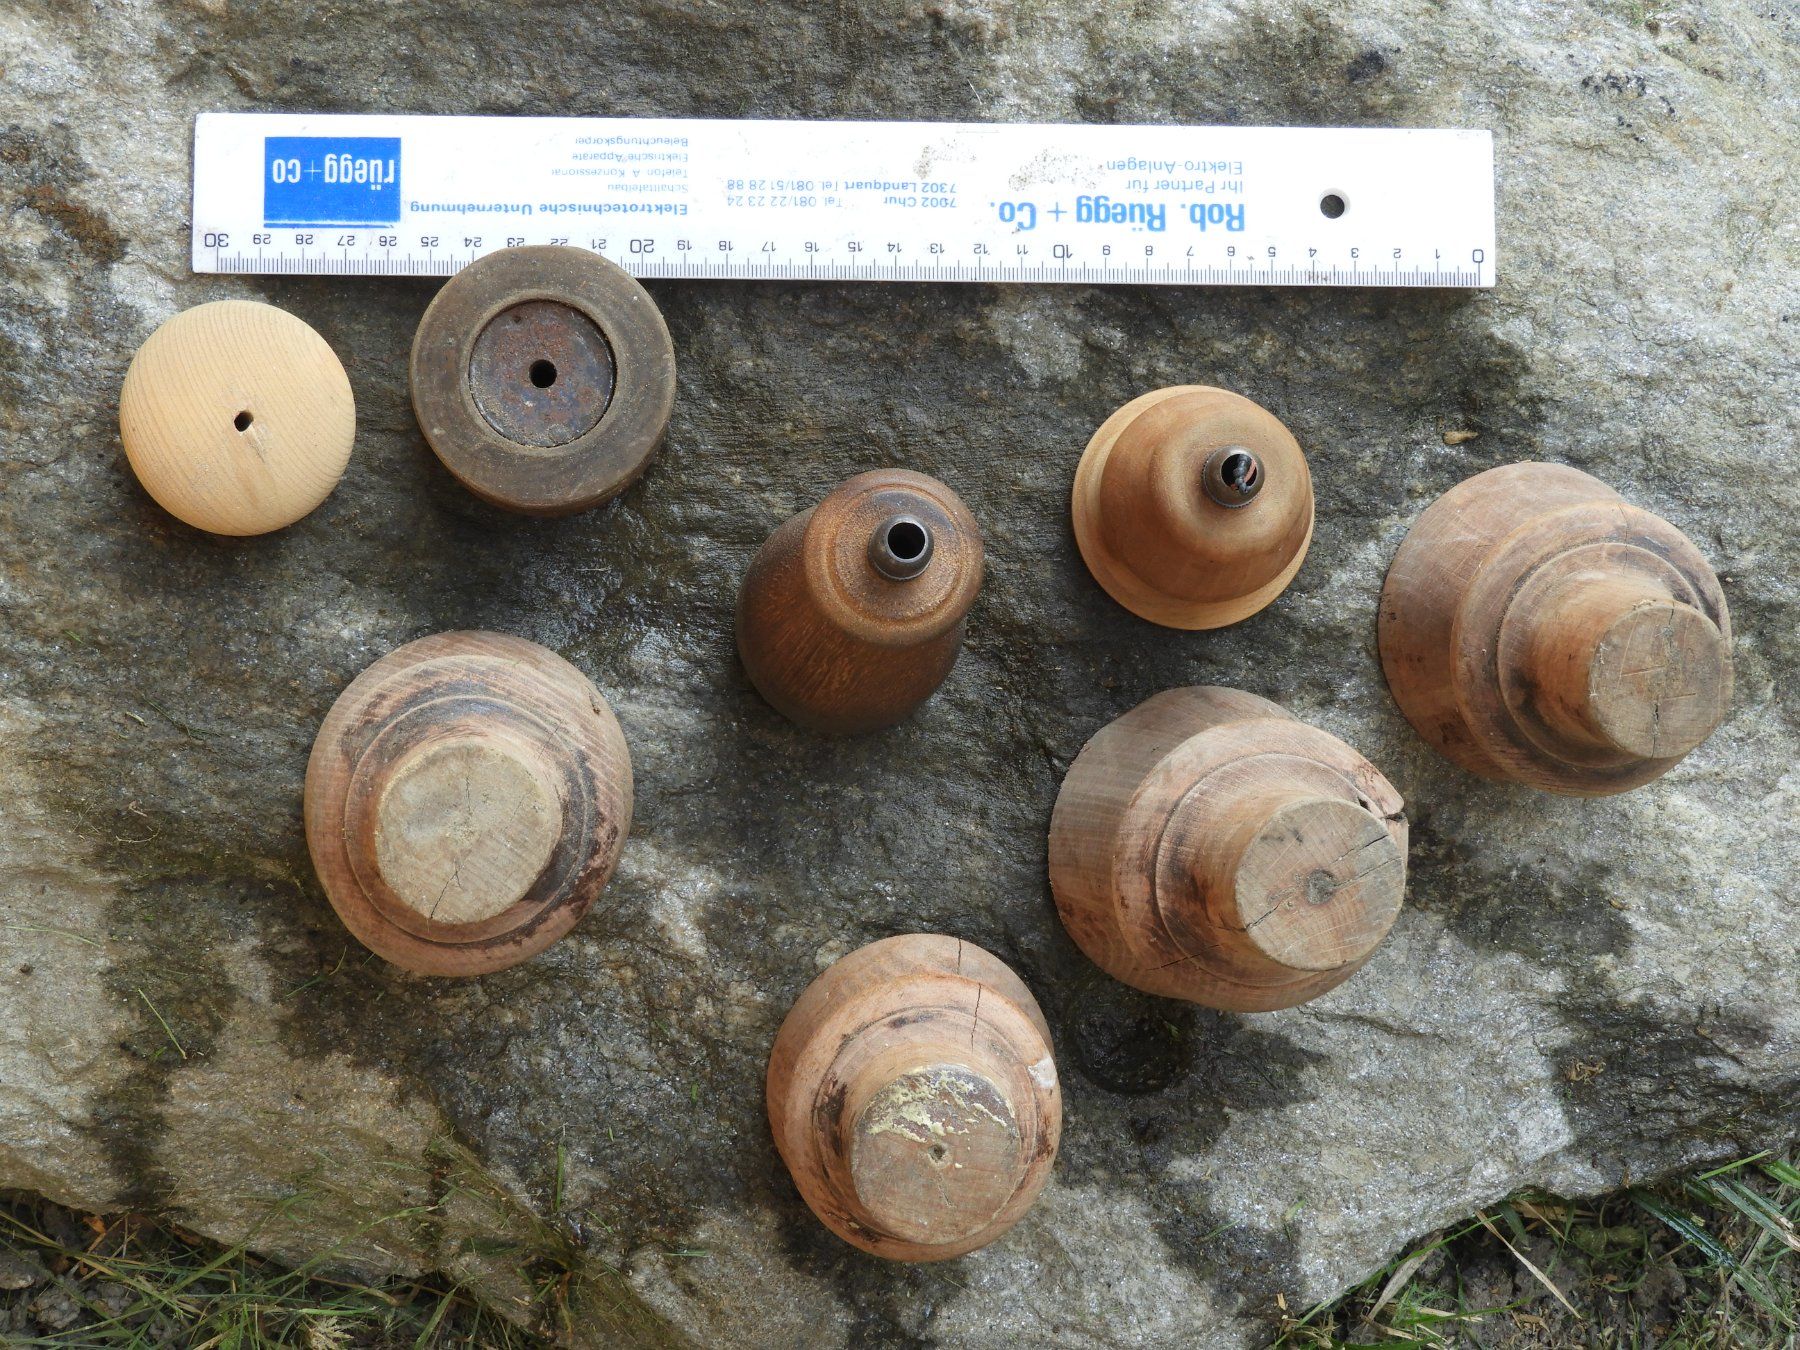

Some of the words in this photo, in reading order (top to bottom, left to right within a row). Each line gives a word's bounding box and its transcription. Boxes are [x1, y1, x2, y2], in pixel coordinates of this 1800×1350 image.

[572, 151, 623, 162] Apparate
[628, 153, 688, 162] Elektrische
[1106, 159, 1242, 174] Elektro-Anlagen
[647, 169, 688, 178] Telefon
[727, 180, 744, 190] 88
[749, 180, 765, 190] 28
[770, 180, 814, 191] 081/51
[844, 180, 917, 192] Landquart
[921, 182, 957, 193] 7302
[1126, 180, 1148, 193] für
[1155, 180, 1214, 193] Partner
[1221, 181, 1243, 192] Ihr
[727, 196, 743, 207] 24
[748, 196, 765, 207] 23
[770, 196, 816, 207] 081/22
[883, 197, 917, 208] Chur
[410, 201, 532, 215] Unternehmung
[539, 203, 688, 215] Elektrotechnische
[1047, 202, 1067, 222] +
[989, 202, 1037, 231] Co.
[1076, 196, 1166, 232] Rüegg
[1180, 202, 1245, 232] Rob.
[204, 233, 229, 248] 30
[253, 234, 271, 245] 29
[295, 234, 313, 245] 28
[337, 235, 355, 246] 27
[379, 235, 397, 246] 26
[420, 236, 439, 247] 25
[464, 237, 482, 248] 24
[507, 237, 525, 248] 23
[592, 239, 606, 249] 21
[677, 240, 692, 250] 19
[629, 239, 654, 253] 20
[718, 241, 732, 251] 18
[762, 241, 775, 252] 17
[804, 242, 819, 252] 16
[848, 242, 862, 252] 15
[887, 242, 902, 253] 14
[929, 243, 944, 253] 13
[973, 243, 988, 254] 12
[1017, 244, 1028, 254] 11
[1053, 244, 1072, 258] 10
[1102, 245, 1111, 255] 9
[1145, 245, 1153, 255] 8
[1186, 246, 1194, 256] 7
[1227, 246, 1235, 256] 6
[1268, 247, 1276, 257] 5
[1309, 248, 1317, 257] 4
[1351, 248, 1359, 258] 3
[1393, 248, 1401, 258] 2
[1435, 249, 1440, 259] 1
[1472, 249, 1484, 263] 0
